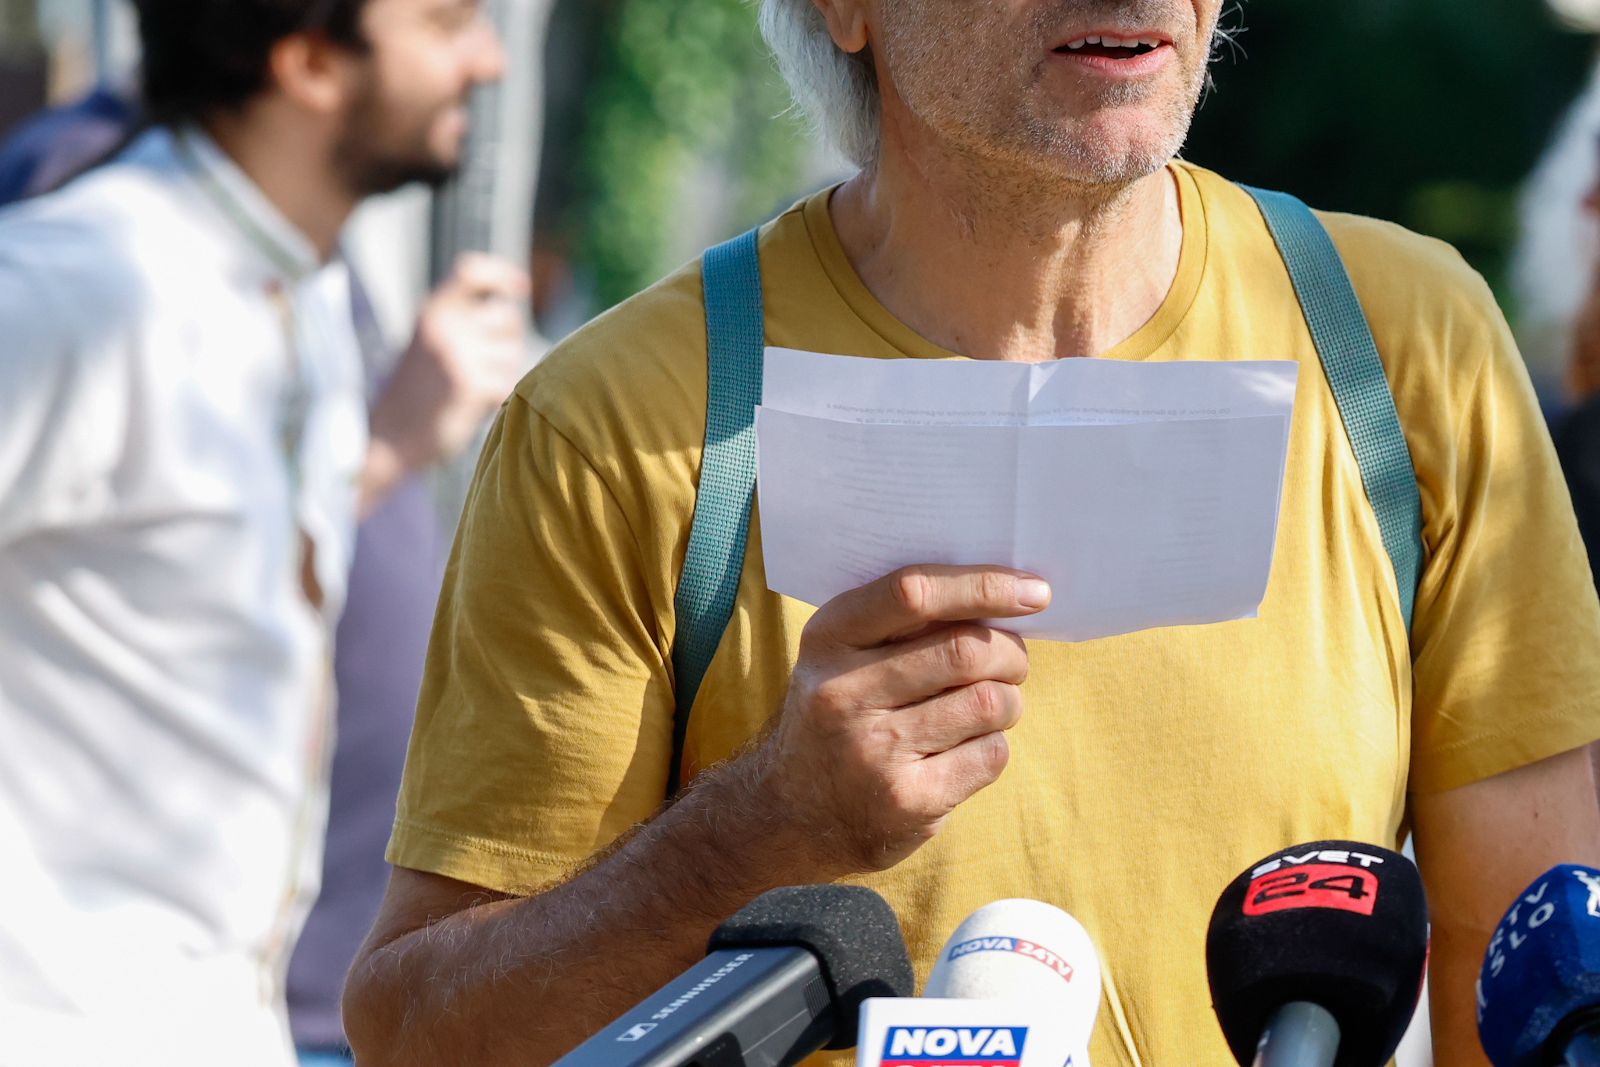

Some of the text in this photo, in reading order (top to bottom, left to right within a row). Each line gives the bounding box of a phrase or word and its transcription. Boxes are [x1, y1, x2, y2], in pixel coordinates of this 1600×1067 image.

[1250, 850, 1384, 880] SVET
[1253, 872, 1369, 906] 24
[1489, 881, 1549, 957] RTV
[1490, 901, 1555, 978] SLO
[651, 953, 755, 1020] SENNHEISER
[889, 1028, 1018, 1057] NOVA
